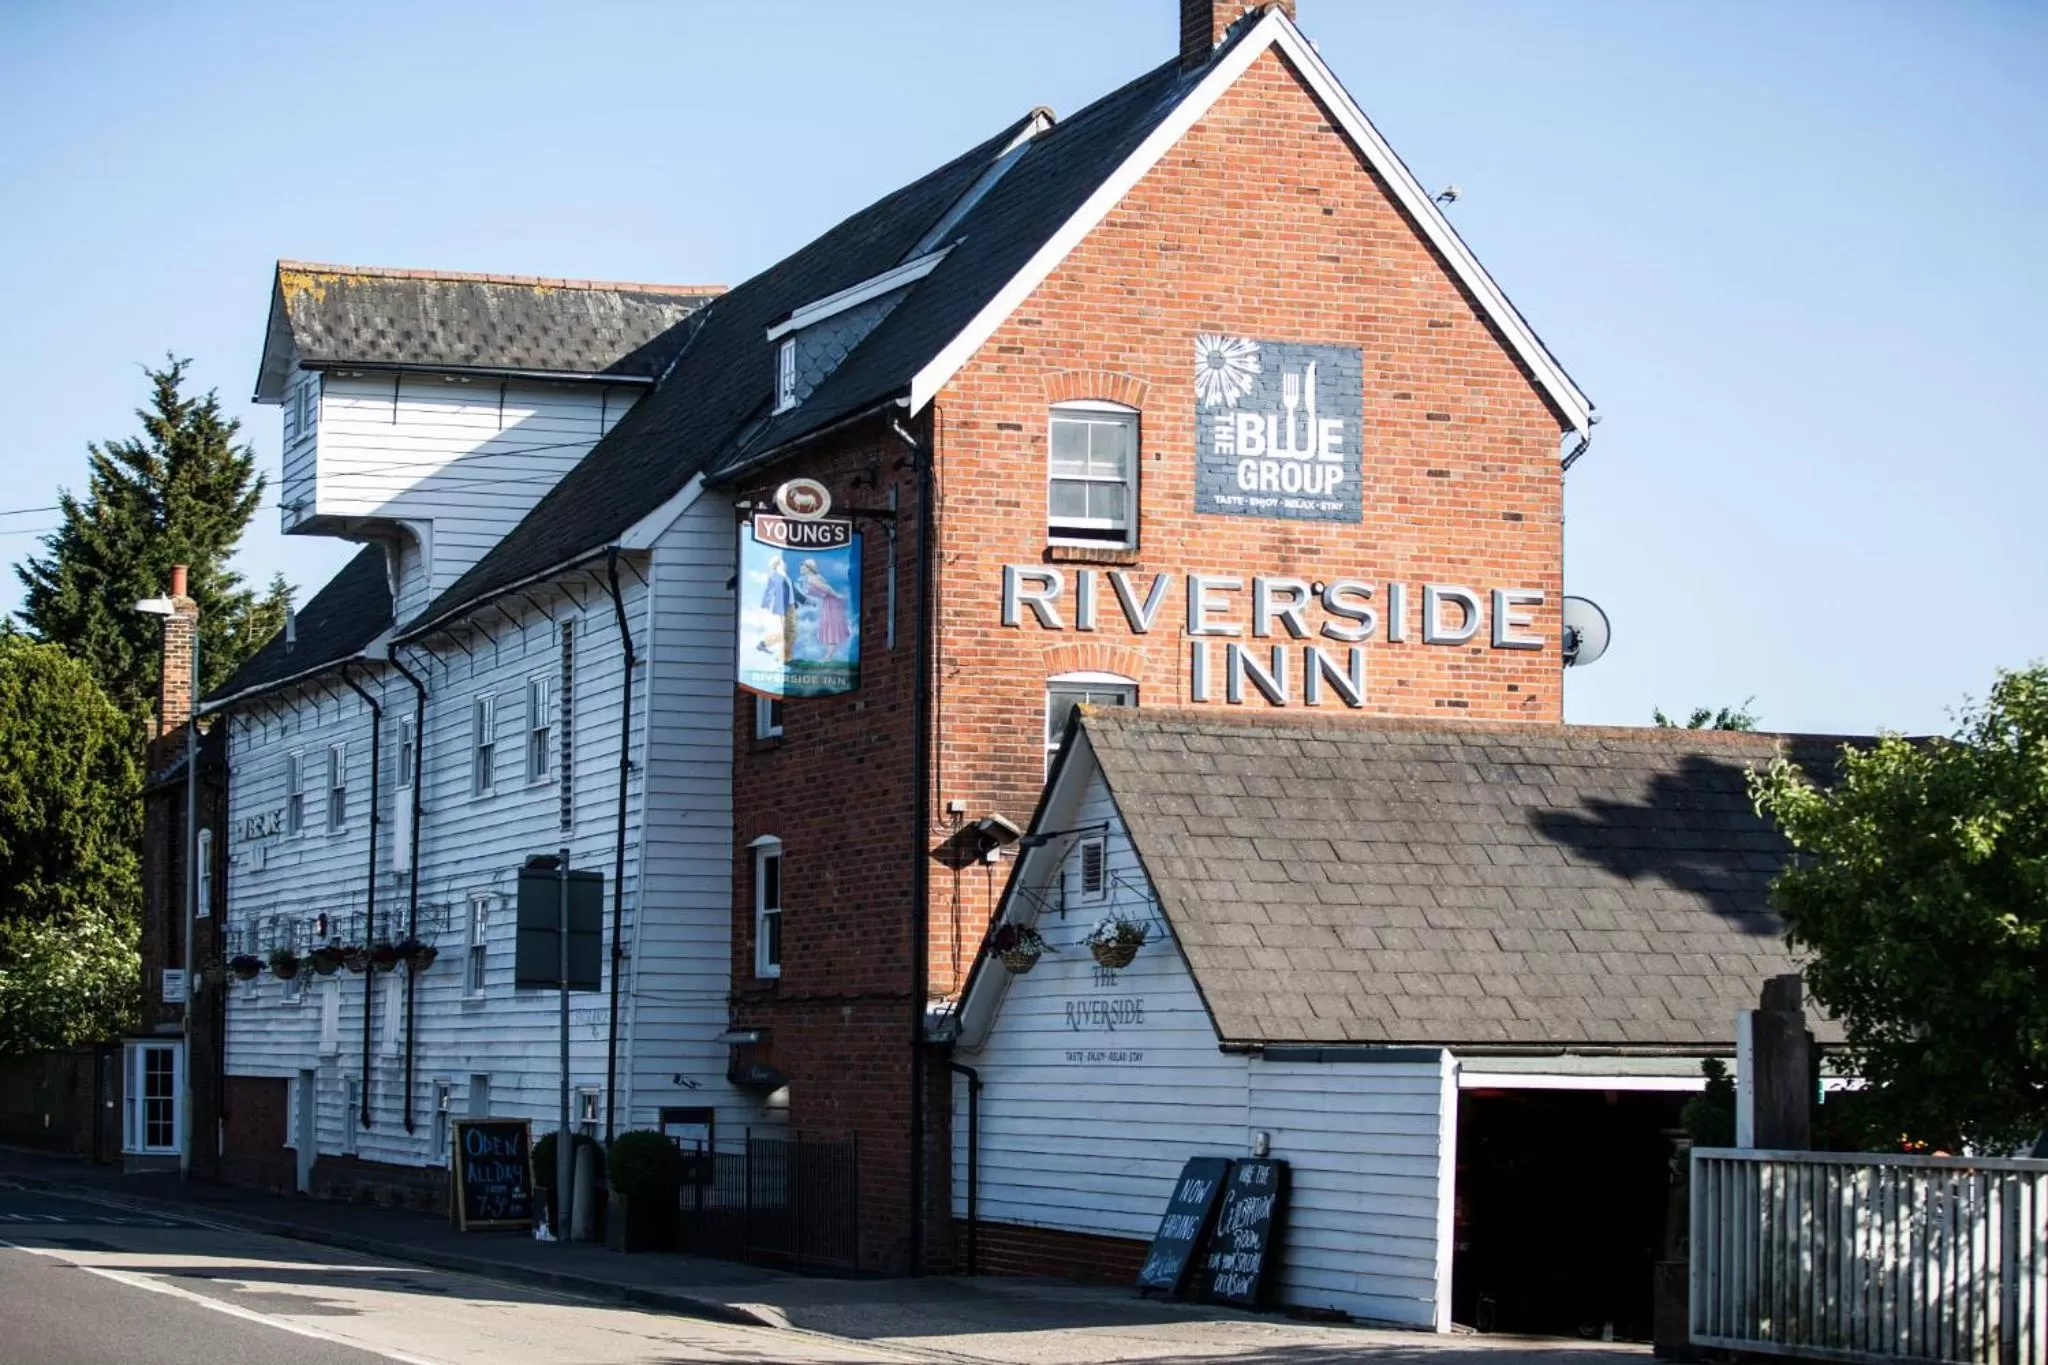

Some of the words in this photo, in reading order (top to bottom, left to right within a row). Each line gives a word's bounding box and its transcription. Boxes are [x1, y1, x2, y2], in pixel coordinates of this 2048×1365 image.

[1214, 412, 1235, 455] THE
[1236, 412, 1344, 462] BLUE
[1238, 459, 1344, 494] GROUP
[1214, 495, 1244, 505] TASTE
[1284, 499, 1314, 509] RELAX
[1320, 501, 1343, 511] STAY
[762, 519, 845, 543] YOUNG'S
[1003, 564, 1545, 650] RIVERSIDE
[751, 671, 818, 685] RIVERSIDE
[823, 676, 847, 688] INN
[1191, 640, 1366, 707] INN
[1092, 966, 1118, 987] THE
[1065, 999, 1145, 1032] RIVERSIDE
[466, 1128, 520, 1156] OPEN
[467, 1162, 493, 1183] ALL
[1179, 1179, 1212, 1203] NOW
[1160, 1214, 1199, 1240] HIRING
